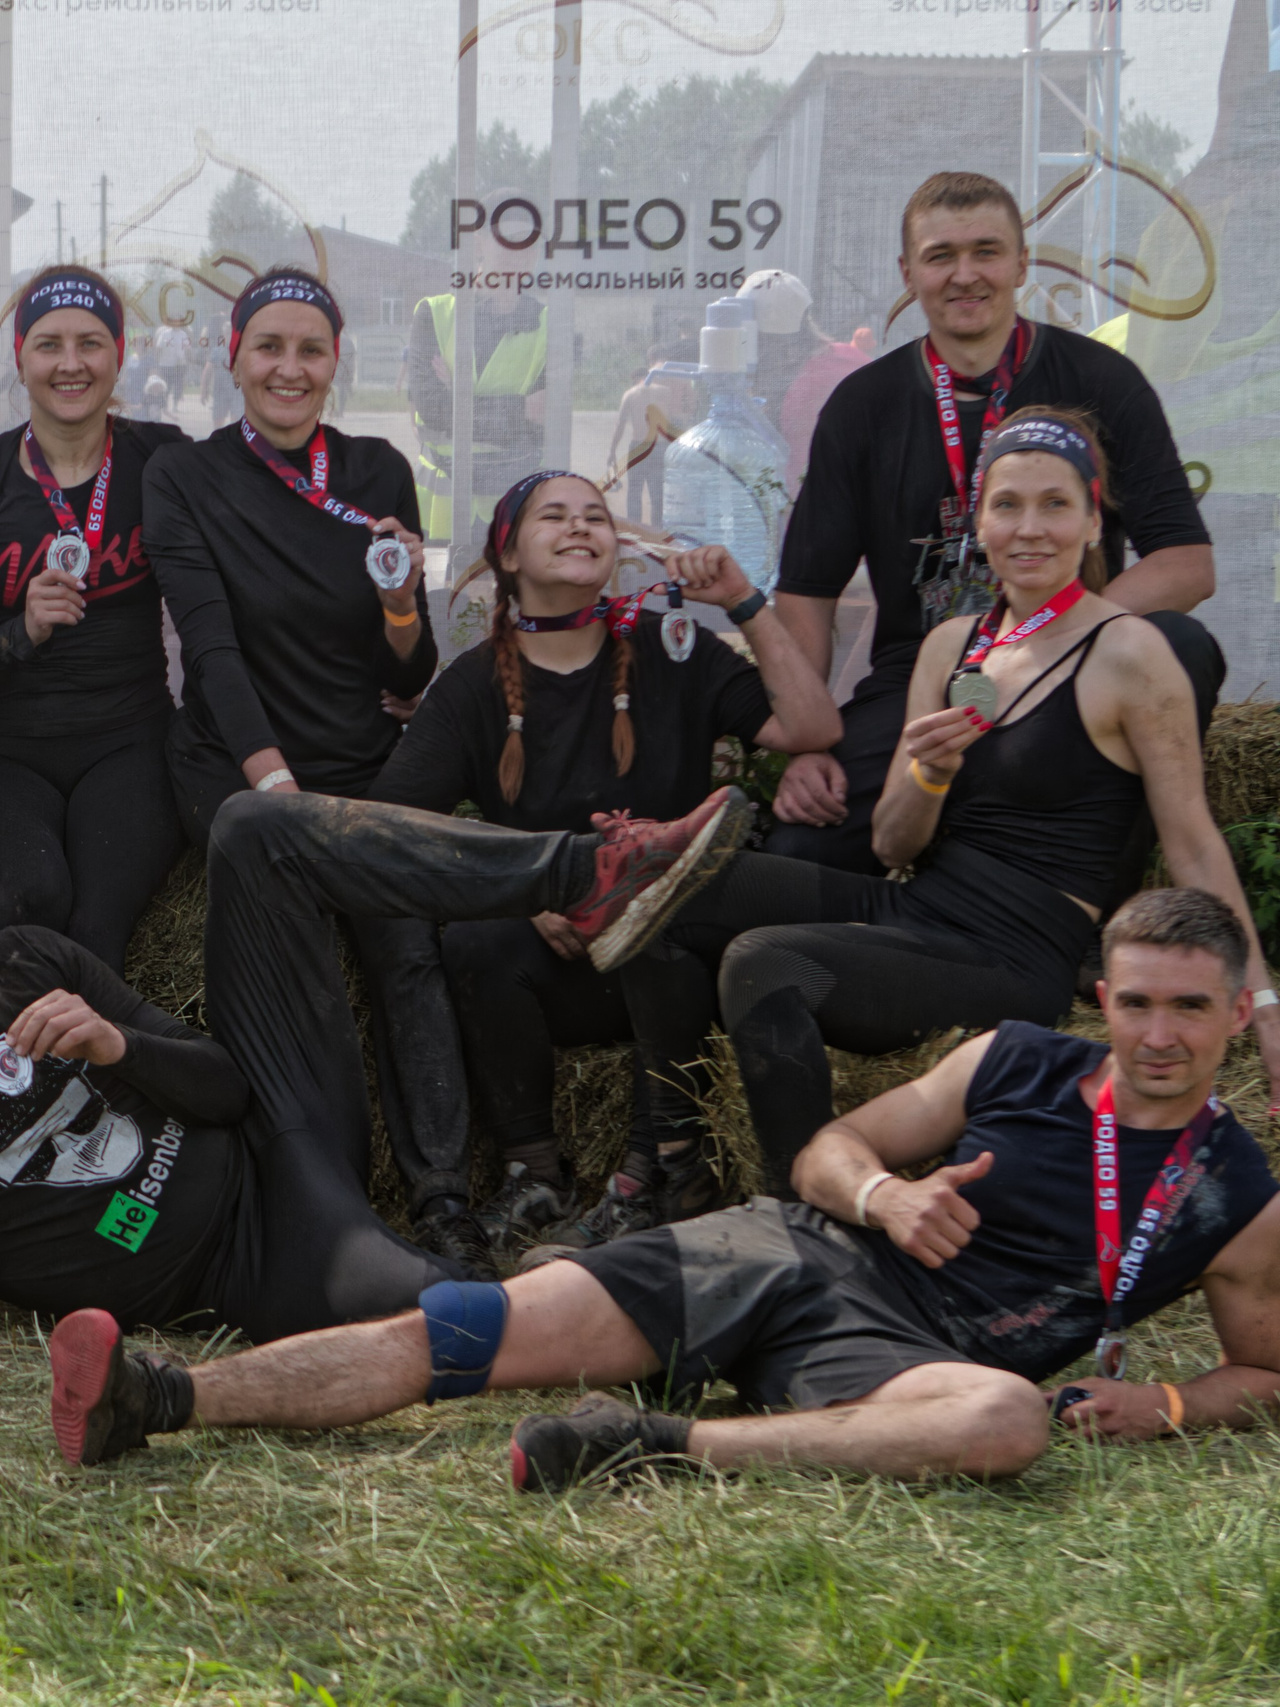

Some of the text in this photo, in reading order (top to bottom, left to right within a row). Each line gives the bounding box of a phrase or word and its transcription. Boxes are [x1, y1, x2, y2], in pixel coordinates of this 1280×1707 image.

[515, 18, 651, 67] ФКС
[450, 198, 783, 260] РОДЕО 59
[31, 280, 91, 304] РОДЕО
[270, 287, 315, 302] 3237
[450, 267, 684, 294] экстремальный
[50, 293, 95, 308] 3240
[121, 280, 195, 328] КС
[935, 363, 961, 447] РОДЕО 59
[997, 421, 1064, 439] РОДЕО
[88, 456, 112, 532] РОДЕО 59
[324, 498, 344, 516] 59
[1094, 1113, 1118, 1211] РОДЕО 59
[107, 1117, 186, 1246] Heisenber
[1138, 1207, 1161, 1232] 59
